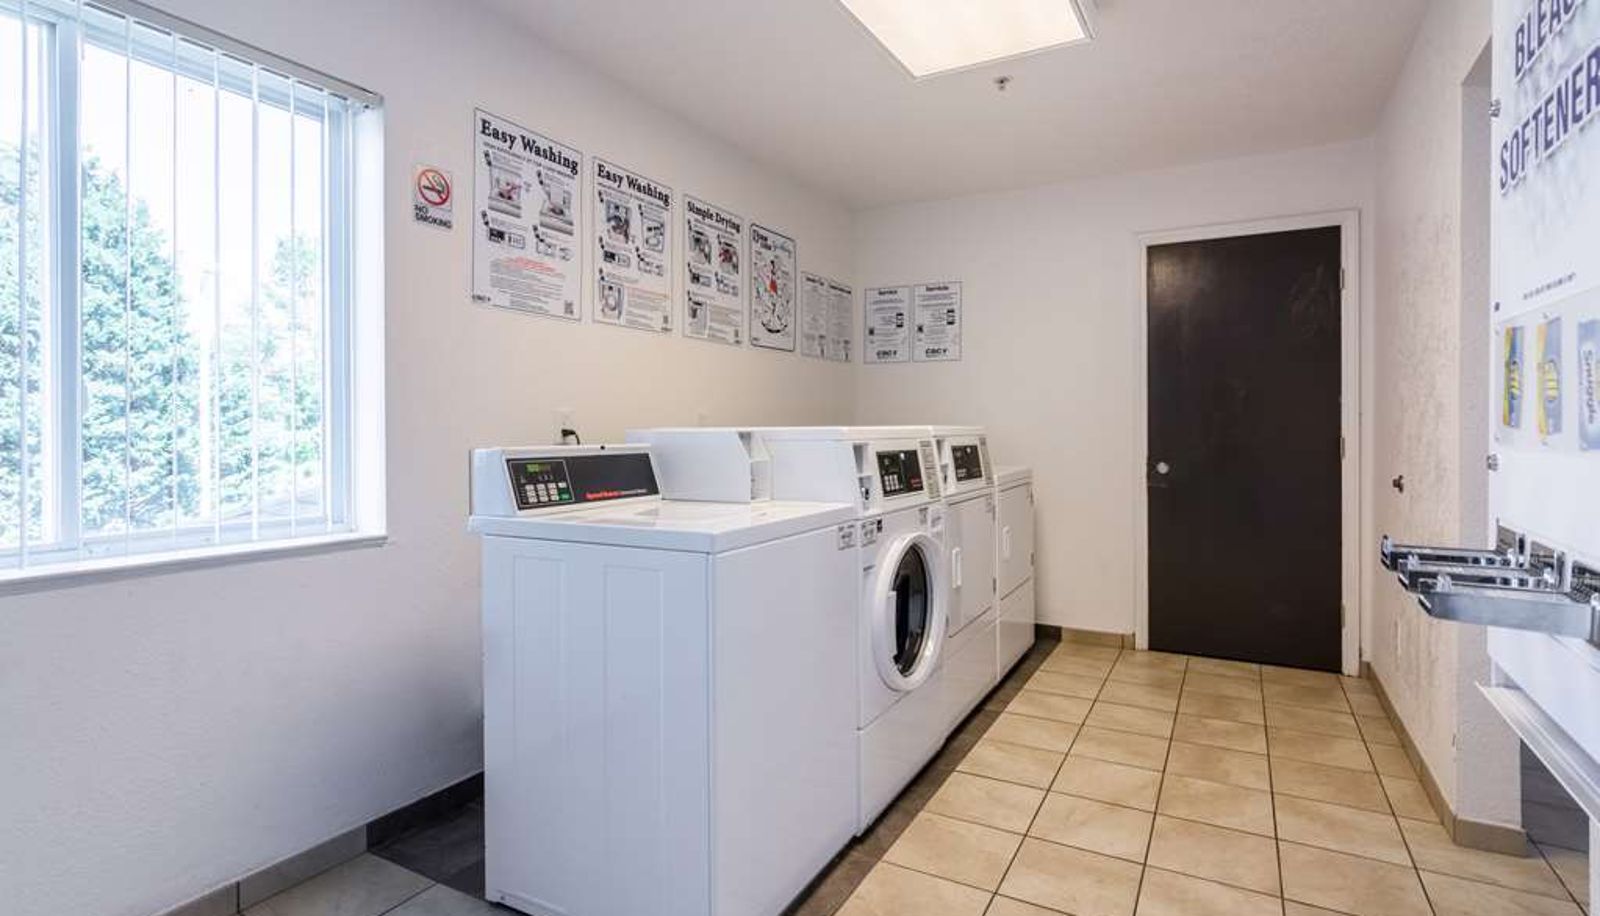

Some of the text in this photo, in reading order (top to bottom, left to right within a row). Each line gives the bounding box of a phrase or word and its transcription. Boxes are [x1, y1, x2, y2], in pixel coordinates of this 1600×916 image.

[1514, 0, 1576, 78] BLEA
[1500, 46, 1600, 191] SOFTENER
[480, 117, 517, 150] Easy
[519, 134, 579, 176] Washing
[597, 162, 624, 188] Easy
[625, 174, 671, 207] Washing
[414, 204, 429, 214] NO
[415, 212, 452, 229] SMOKING
[687, 199, 714, 221] Simple
[715, 212, 741, 234] Drying
